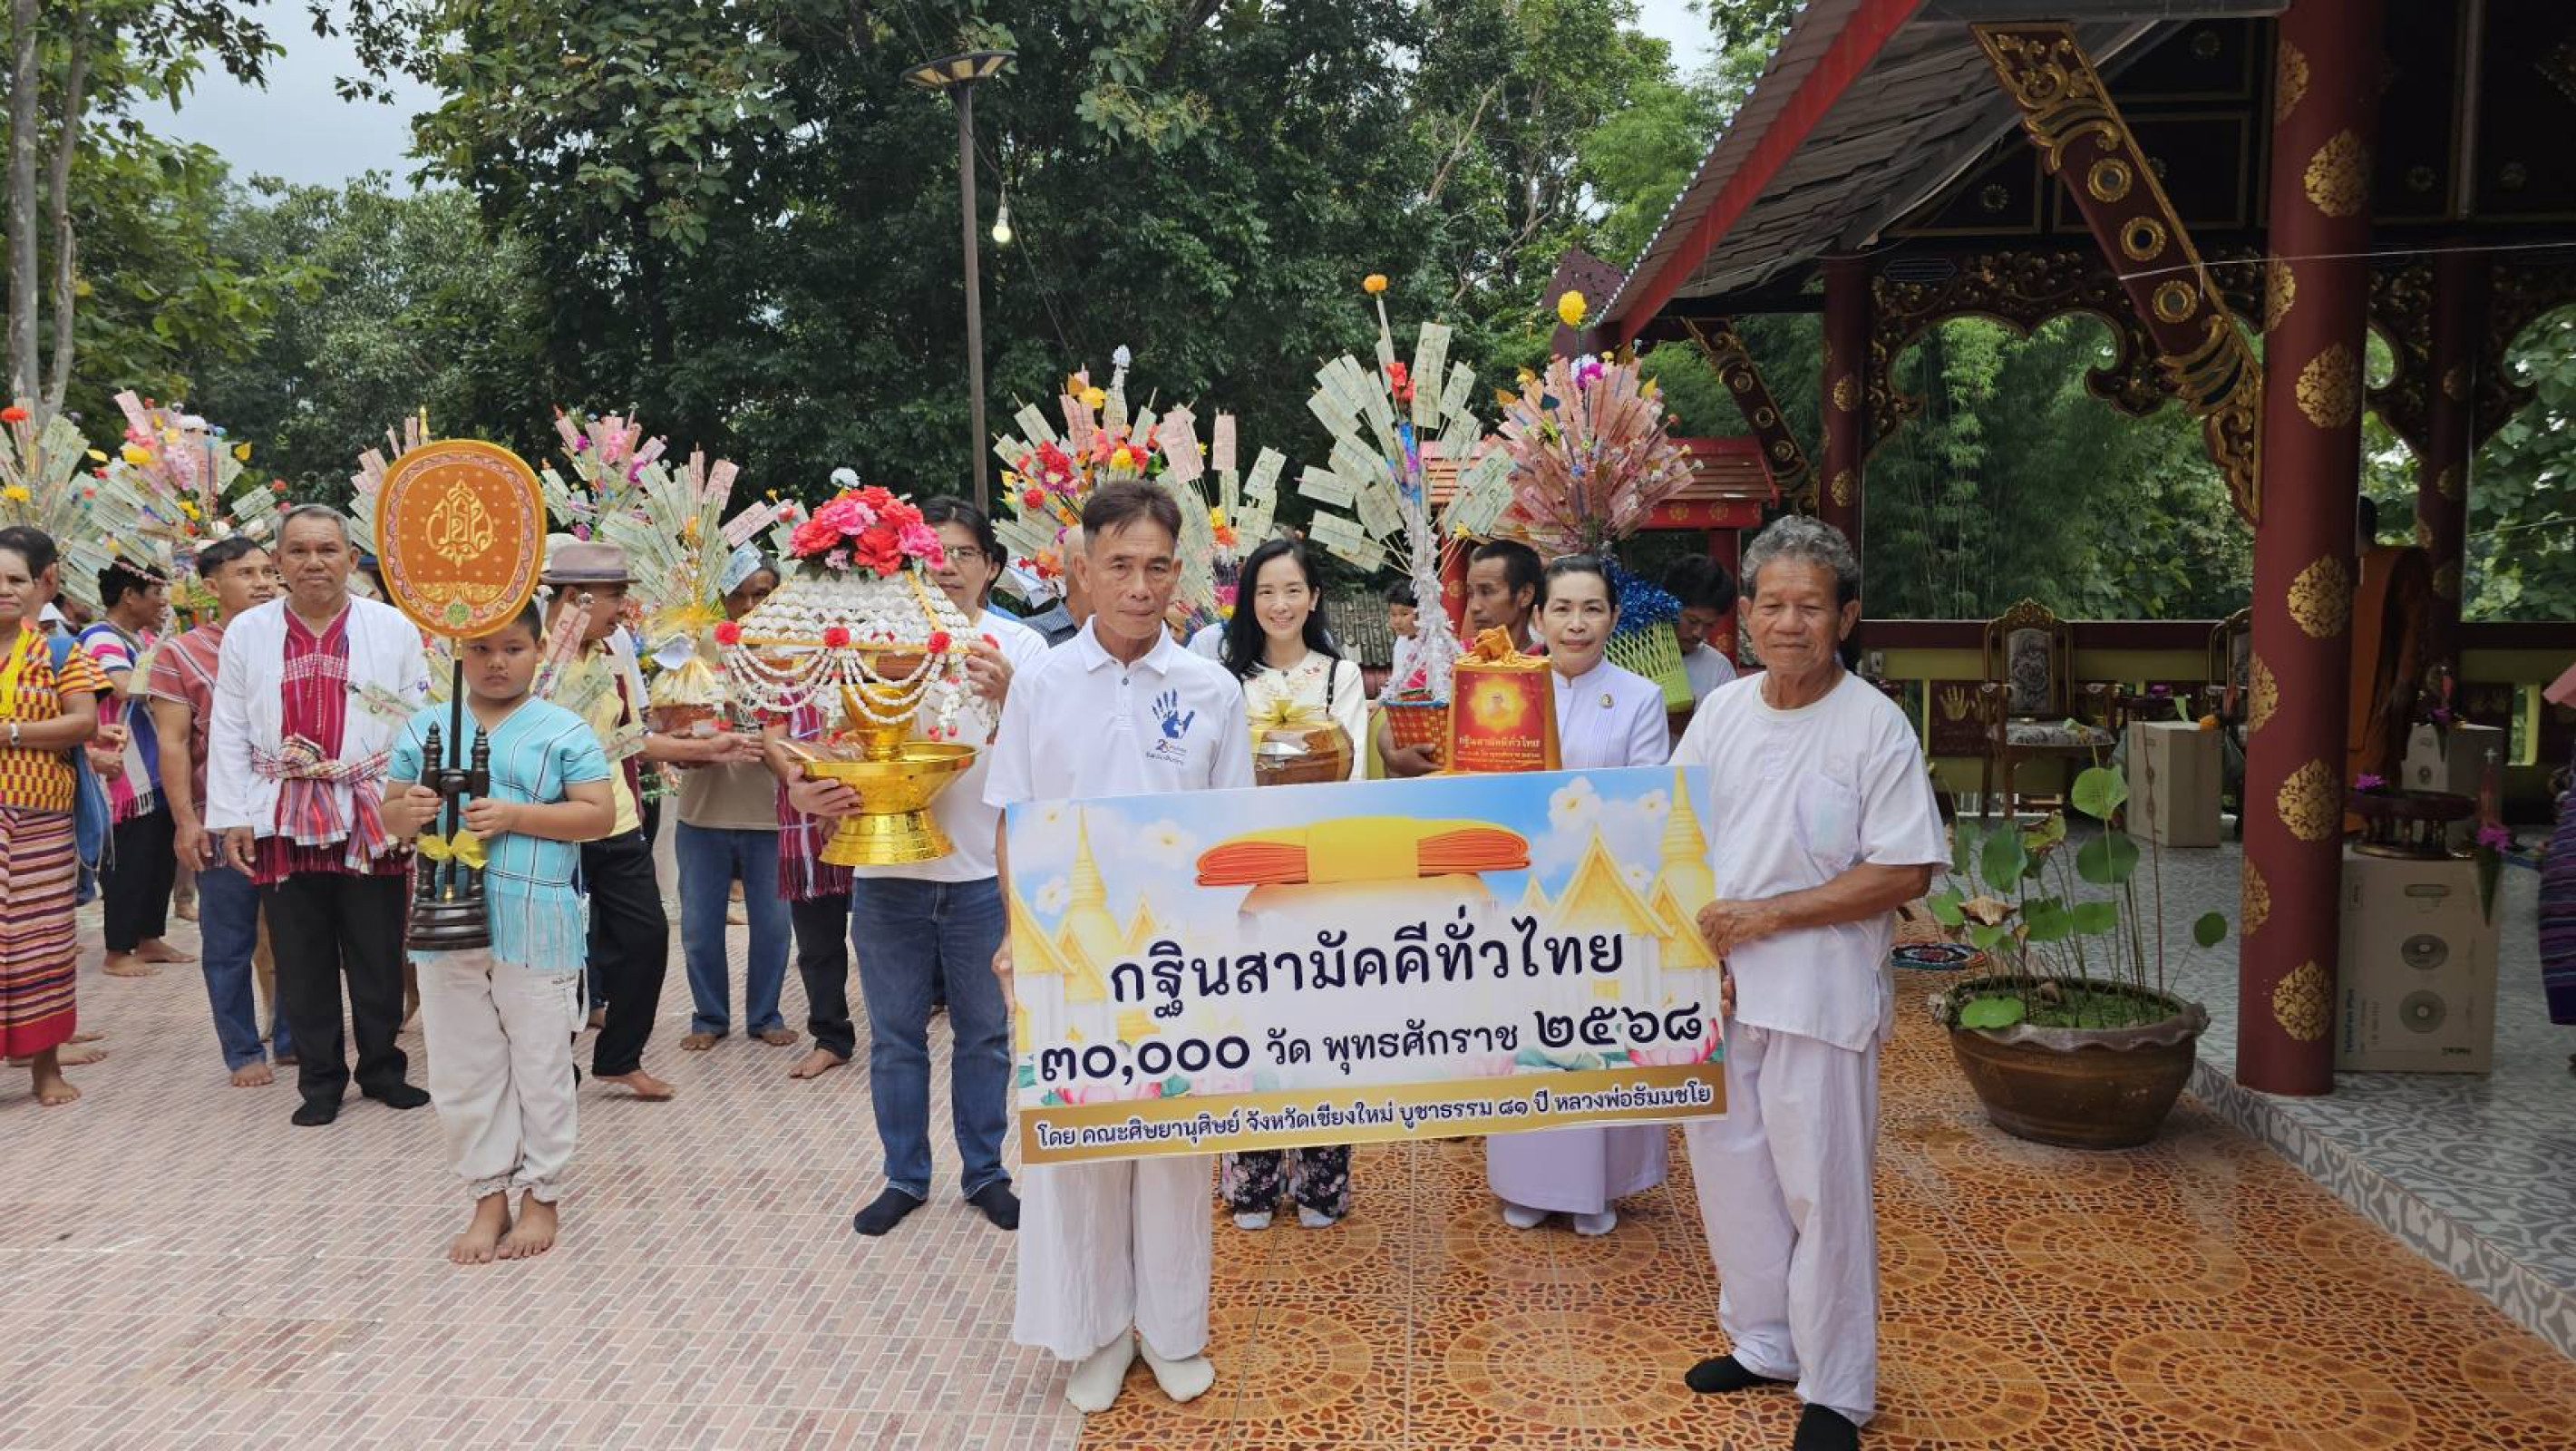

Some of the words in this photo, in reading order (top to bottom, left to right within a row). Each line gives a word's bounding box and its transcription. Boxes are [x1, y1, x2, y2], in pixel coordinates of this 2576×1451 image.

[1110, 905, 1623, 1018] กฐินสามัคคีทั่วไทย
[1040, 1036, 1250, 1086] ๓๐,๐๐๐
[1267, 1027, 1311, 1065] วัด
[1323, 1018, 1518, 1076] พุทธศักราช
[1533, 1001, 1703, 1048] ๒๕๖๘
[1037, 1124, 1075, 1146] โดย
[1083, 1108, 1240, 1144] คณะศิษยานุศิษย์
[1246, 1102, 1394, 1133] จังหวัดเชียงใหม่
[1399, 1097, 1492, 1129] บูชาธรรม
[1498, 1098, 1529, 1115] ๘๑
[1534, 1090, 1550, 1114] ปี
[1554, 1081, 1713, 1111] หลวงพ่อธัมมชโย
